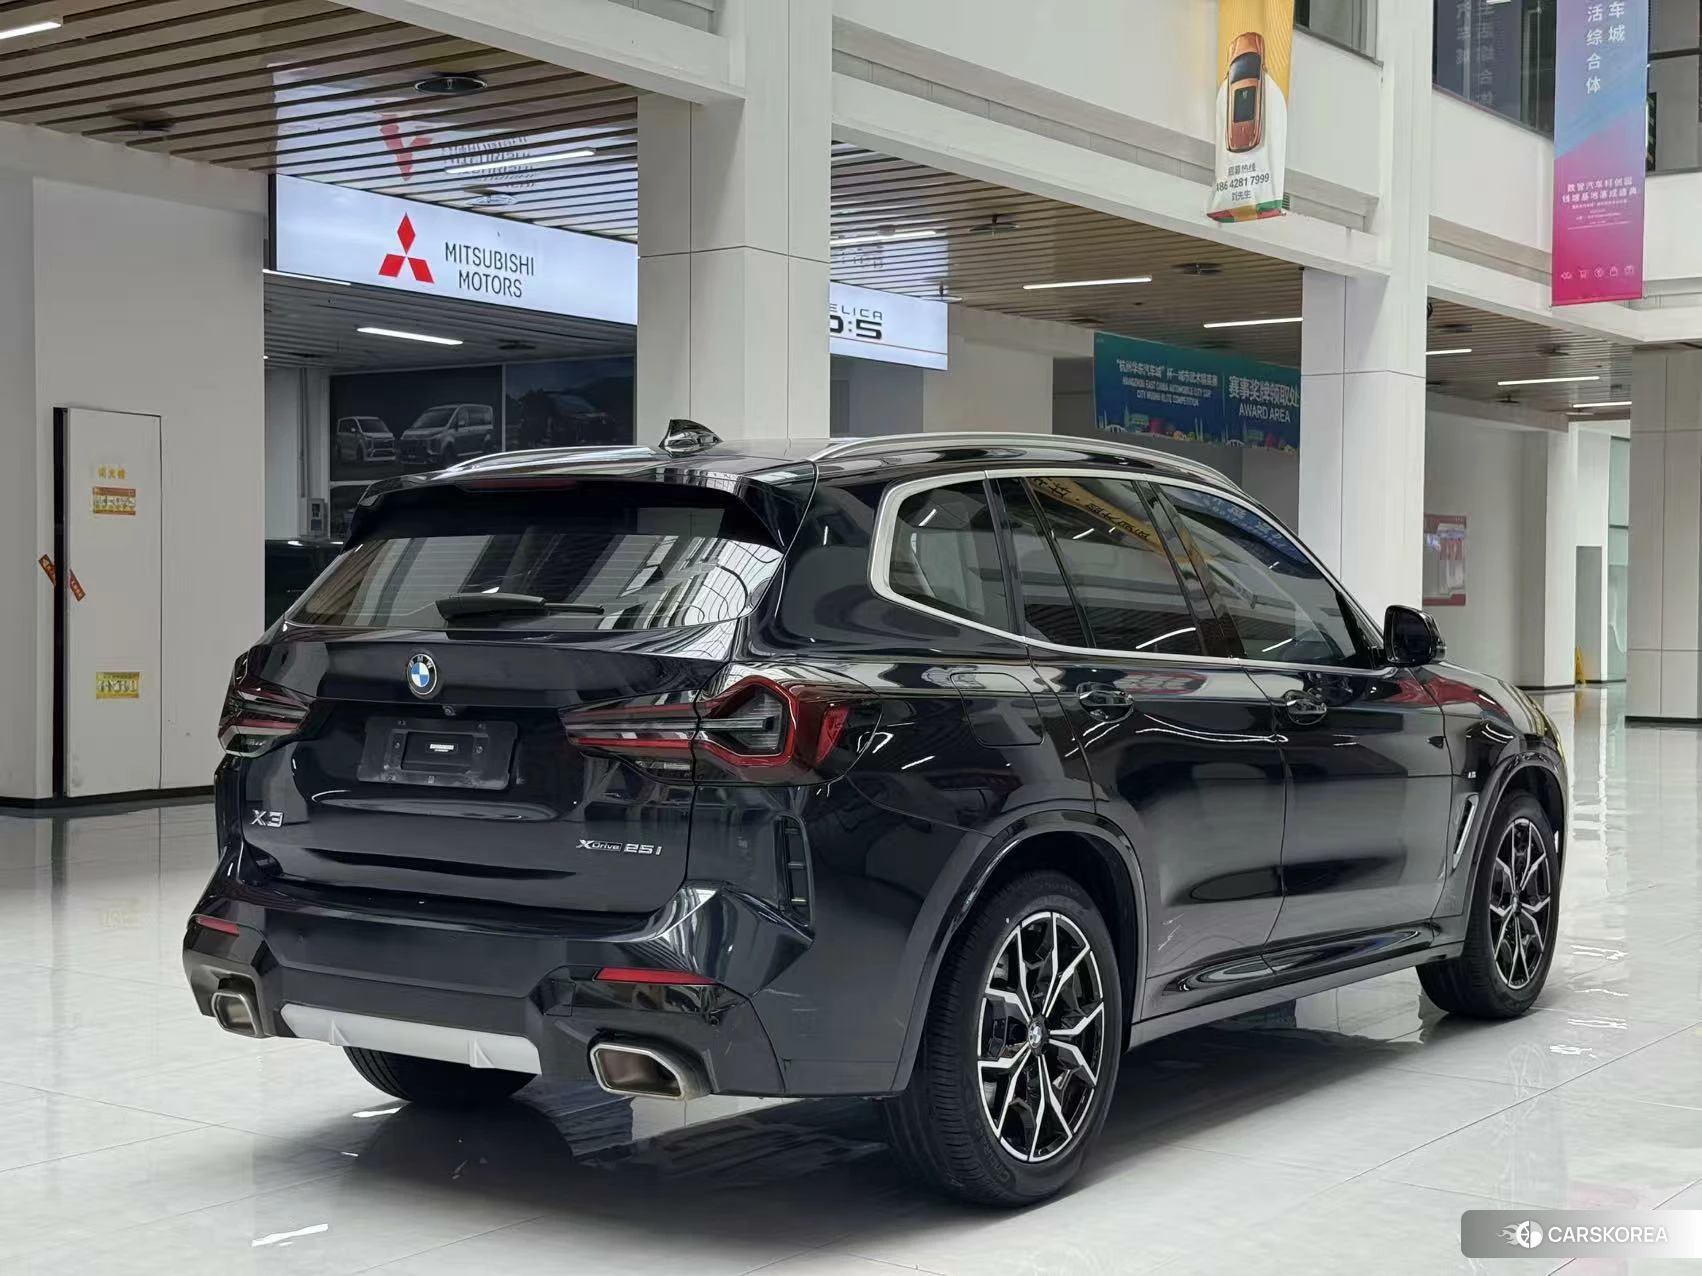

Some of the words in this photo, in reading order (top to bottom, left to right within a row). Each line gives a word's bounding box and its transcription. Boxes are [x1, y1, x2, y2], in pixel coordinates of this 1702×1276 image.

[1586, 4, 1603, 94] 活综合体
[1229, 177, 1248, 189] 4281
[1250, 173, 1270, 185] 7999
[445, 241, 534, 276] MITSUBISHI
[458, 269, 522, 298] MOTORS
[829, 303, 883, 321] ELICA
[1239, 402, 1269, 420] AWARD
[1269, 407, 1291, 423] AREA
[251, 809, 284, 828] X3
